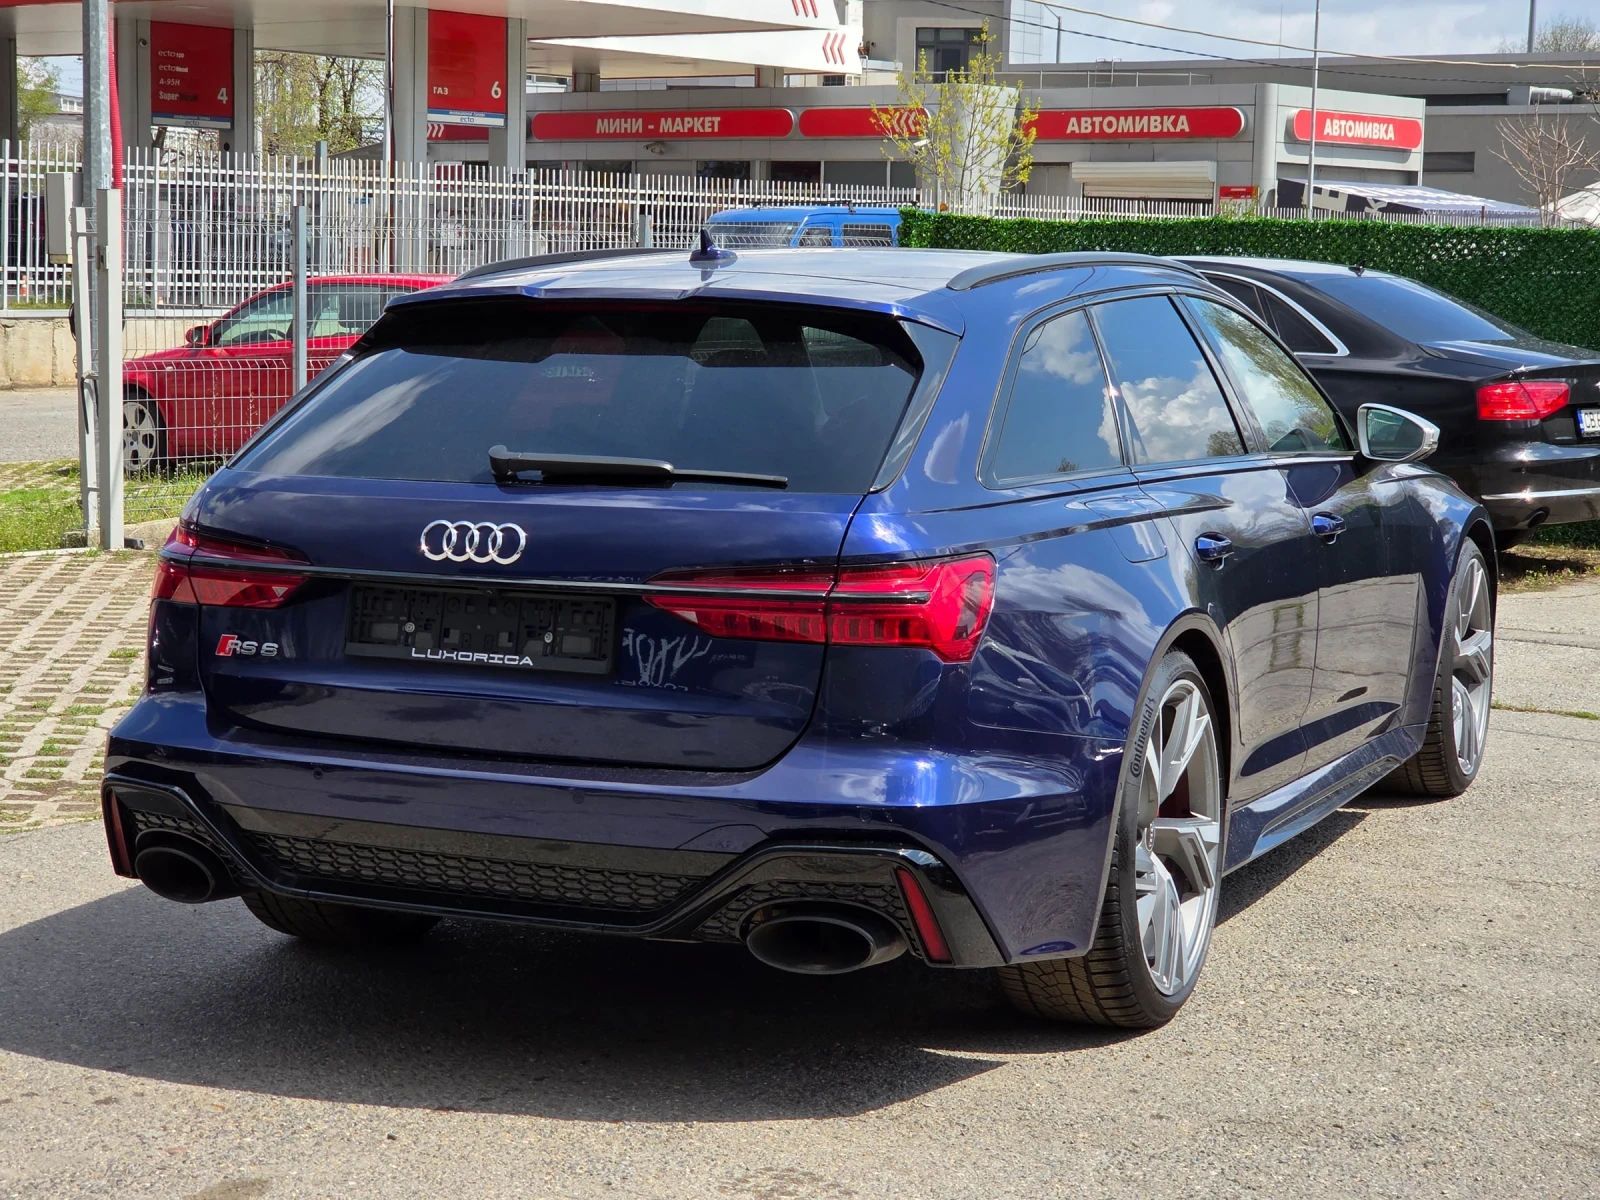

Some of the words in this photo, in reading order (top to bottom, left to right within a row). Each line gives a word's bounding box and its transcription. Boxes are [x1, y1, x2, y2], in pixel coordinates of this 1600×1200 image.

[158, 91, 180, 101] Super
[217, 87, 228, 104] 4
[433, 86, 449, 95] ГАЗ
[491, 80, 502, 99] 6
[596, 118, 643, 134] МИНИ
[659, 116, 721, 133] МАРКЕТ
[1066, 115, 1190, 134] АВТОМИВКА
[1323, 118, 1395, 141] АВТОМИВКА
[411, 647, 534, 666] LUXORICA
[1130, 704, 1154, 778] Continental
